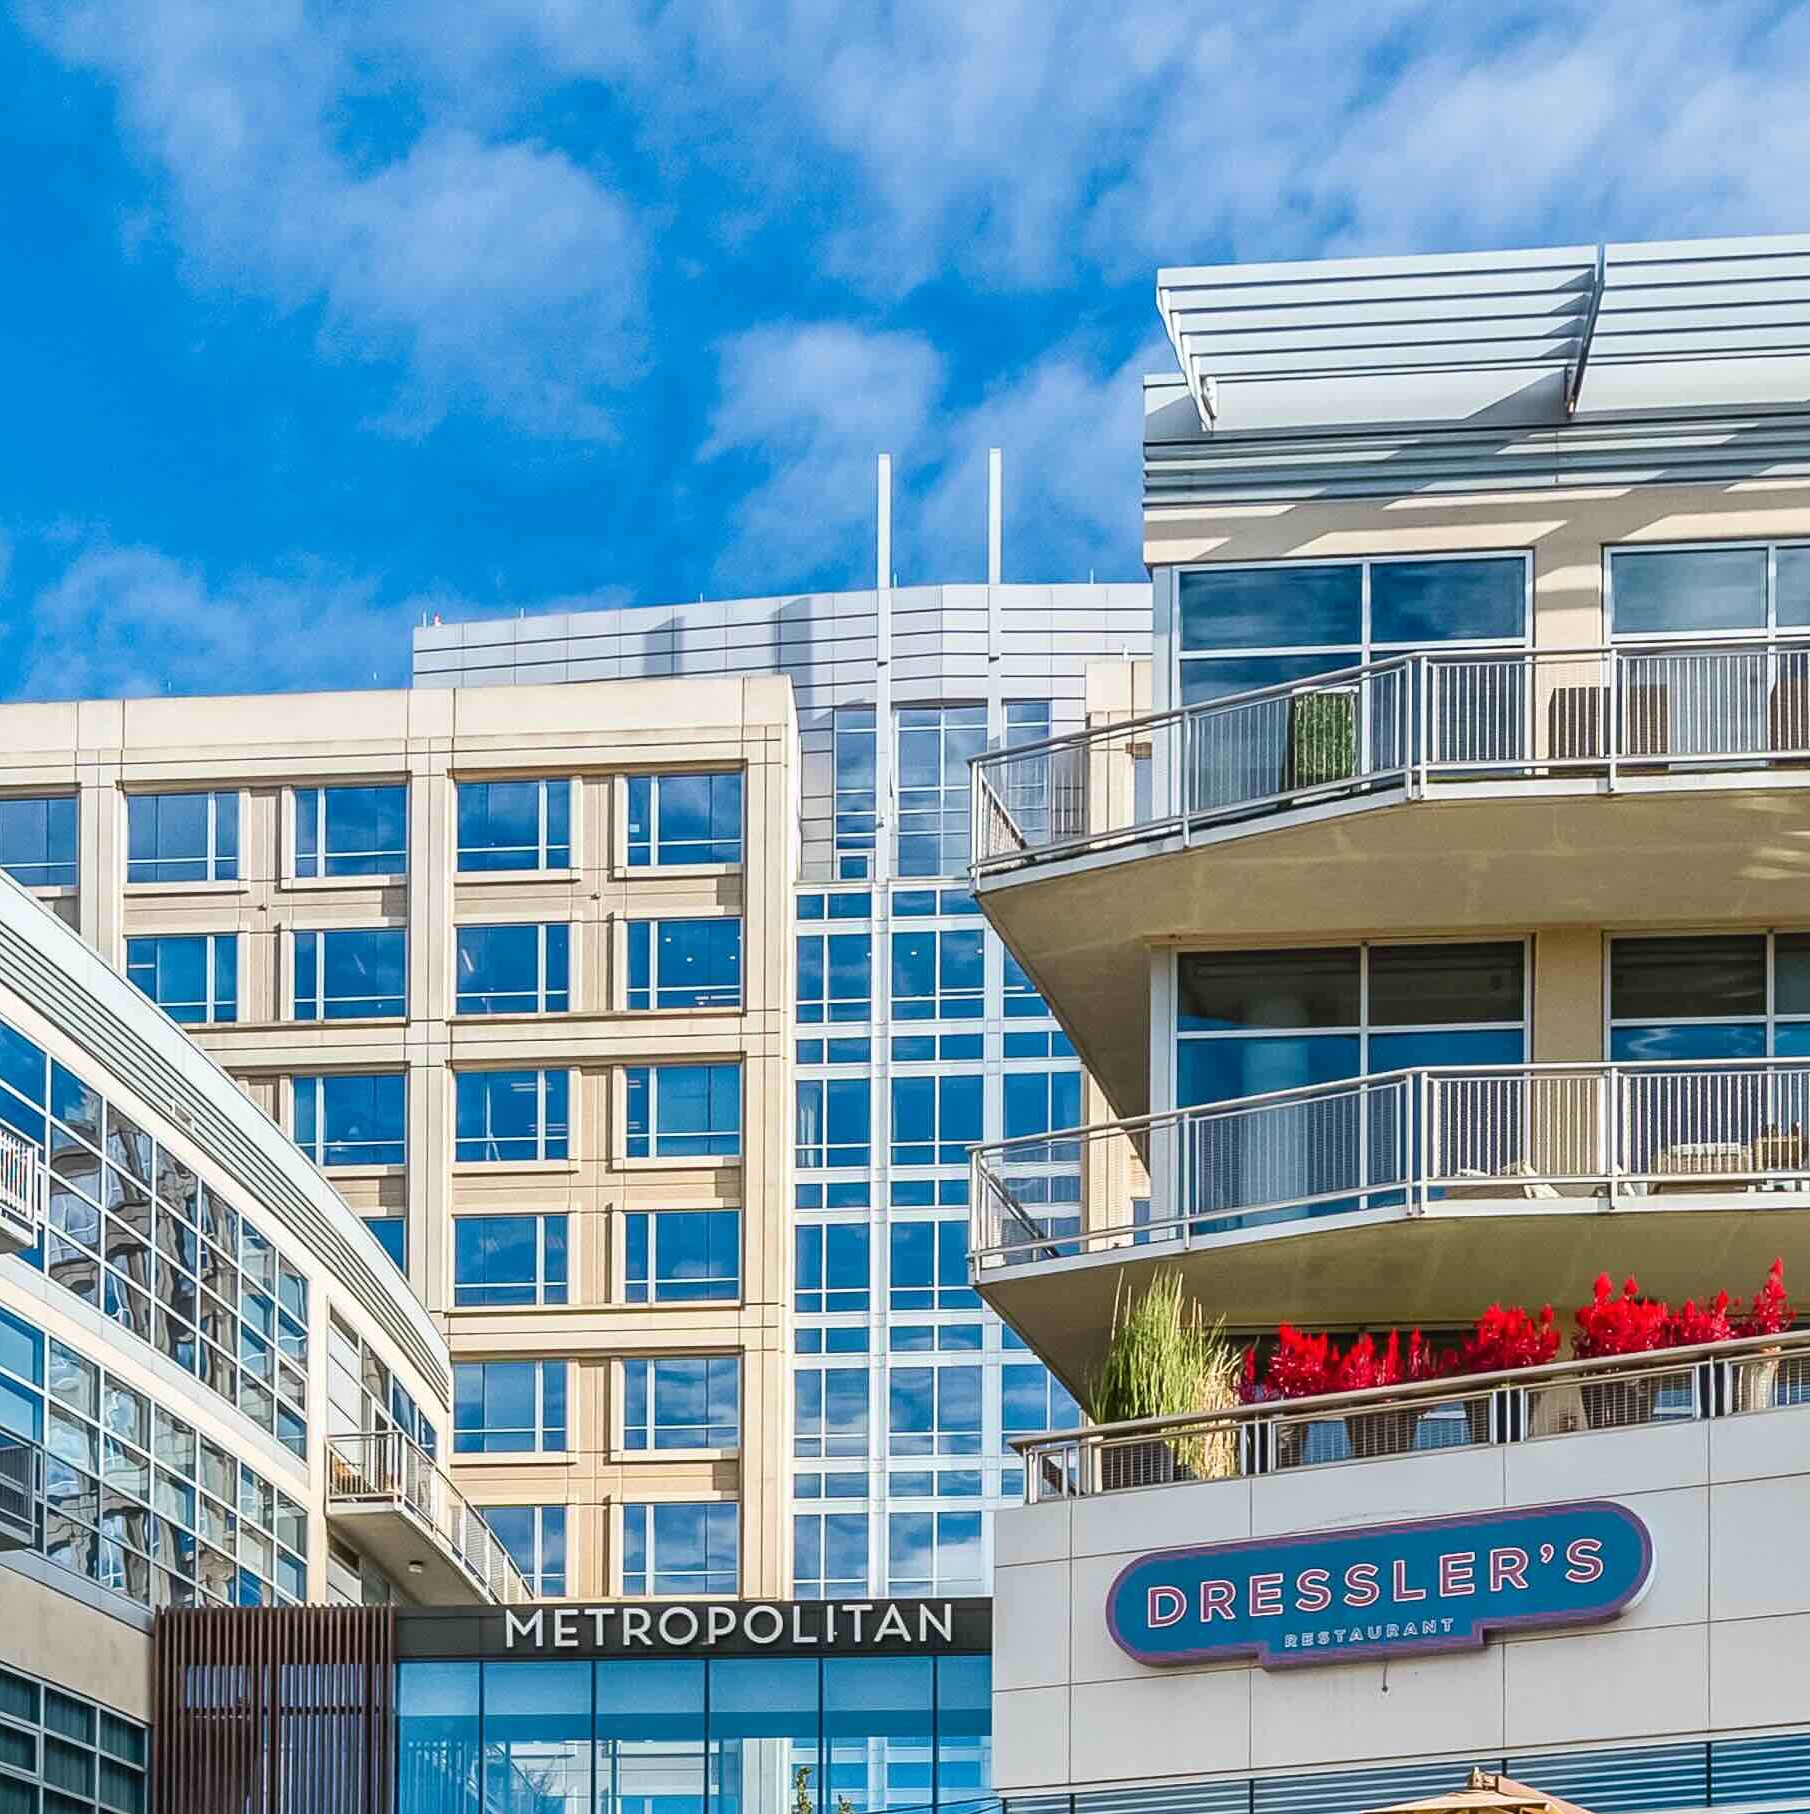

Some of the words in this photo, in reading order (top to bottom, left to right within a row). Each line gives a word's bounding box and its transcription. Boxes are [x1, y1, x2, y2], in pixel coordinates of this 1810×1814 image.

[1146, 1538, 1607, 1629] DRESSLER'S
[505, 1603, 953, 1648] METROPOLITAN
[1284, 1617, 1456, 1648] RESTAURANT
